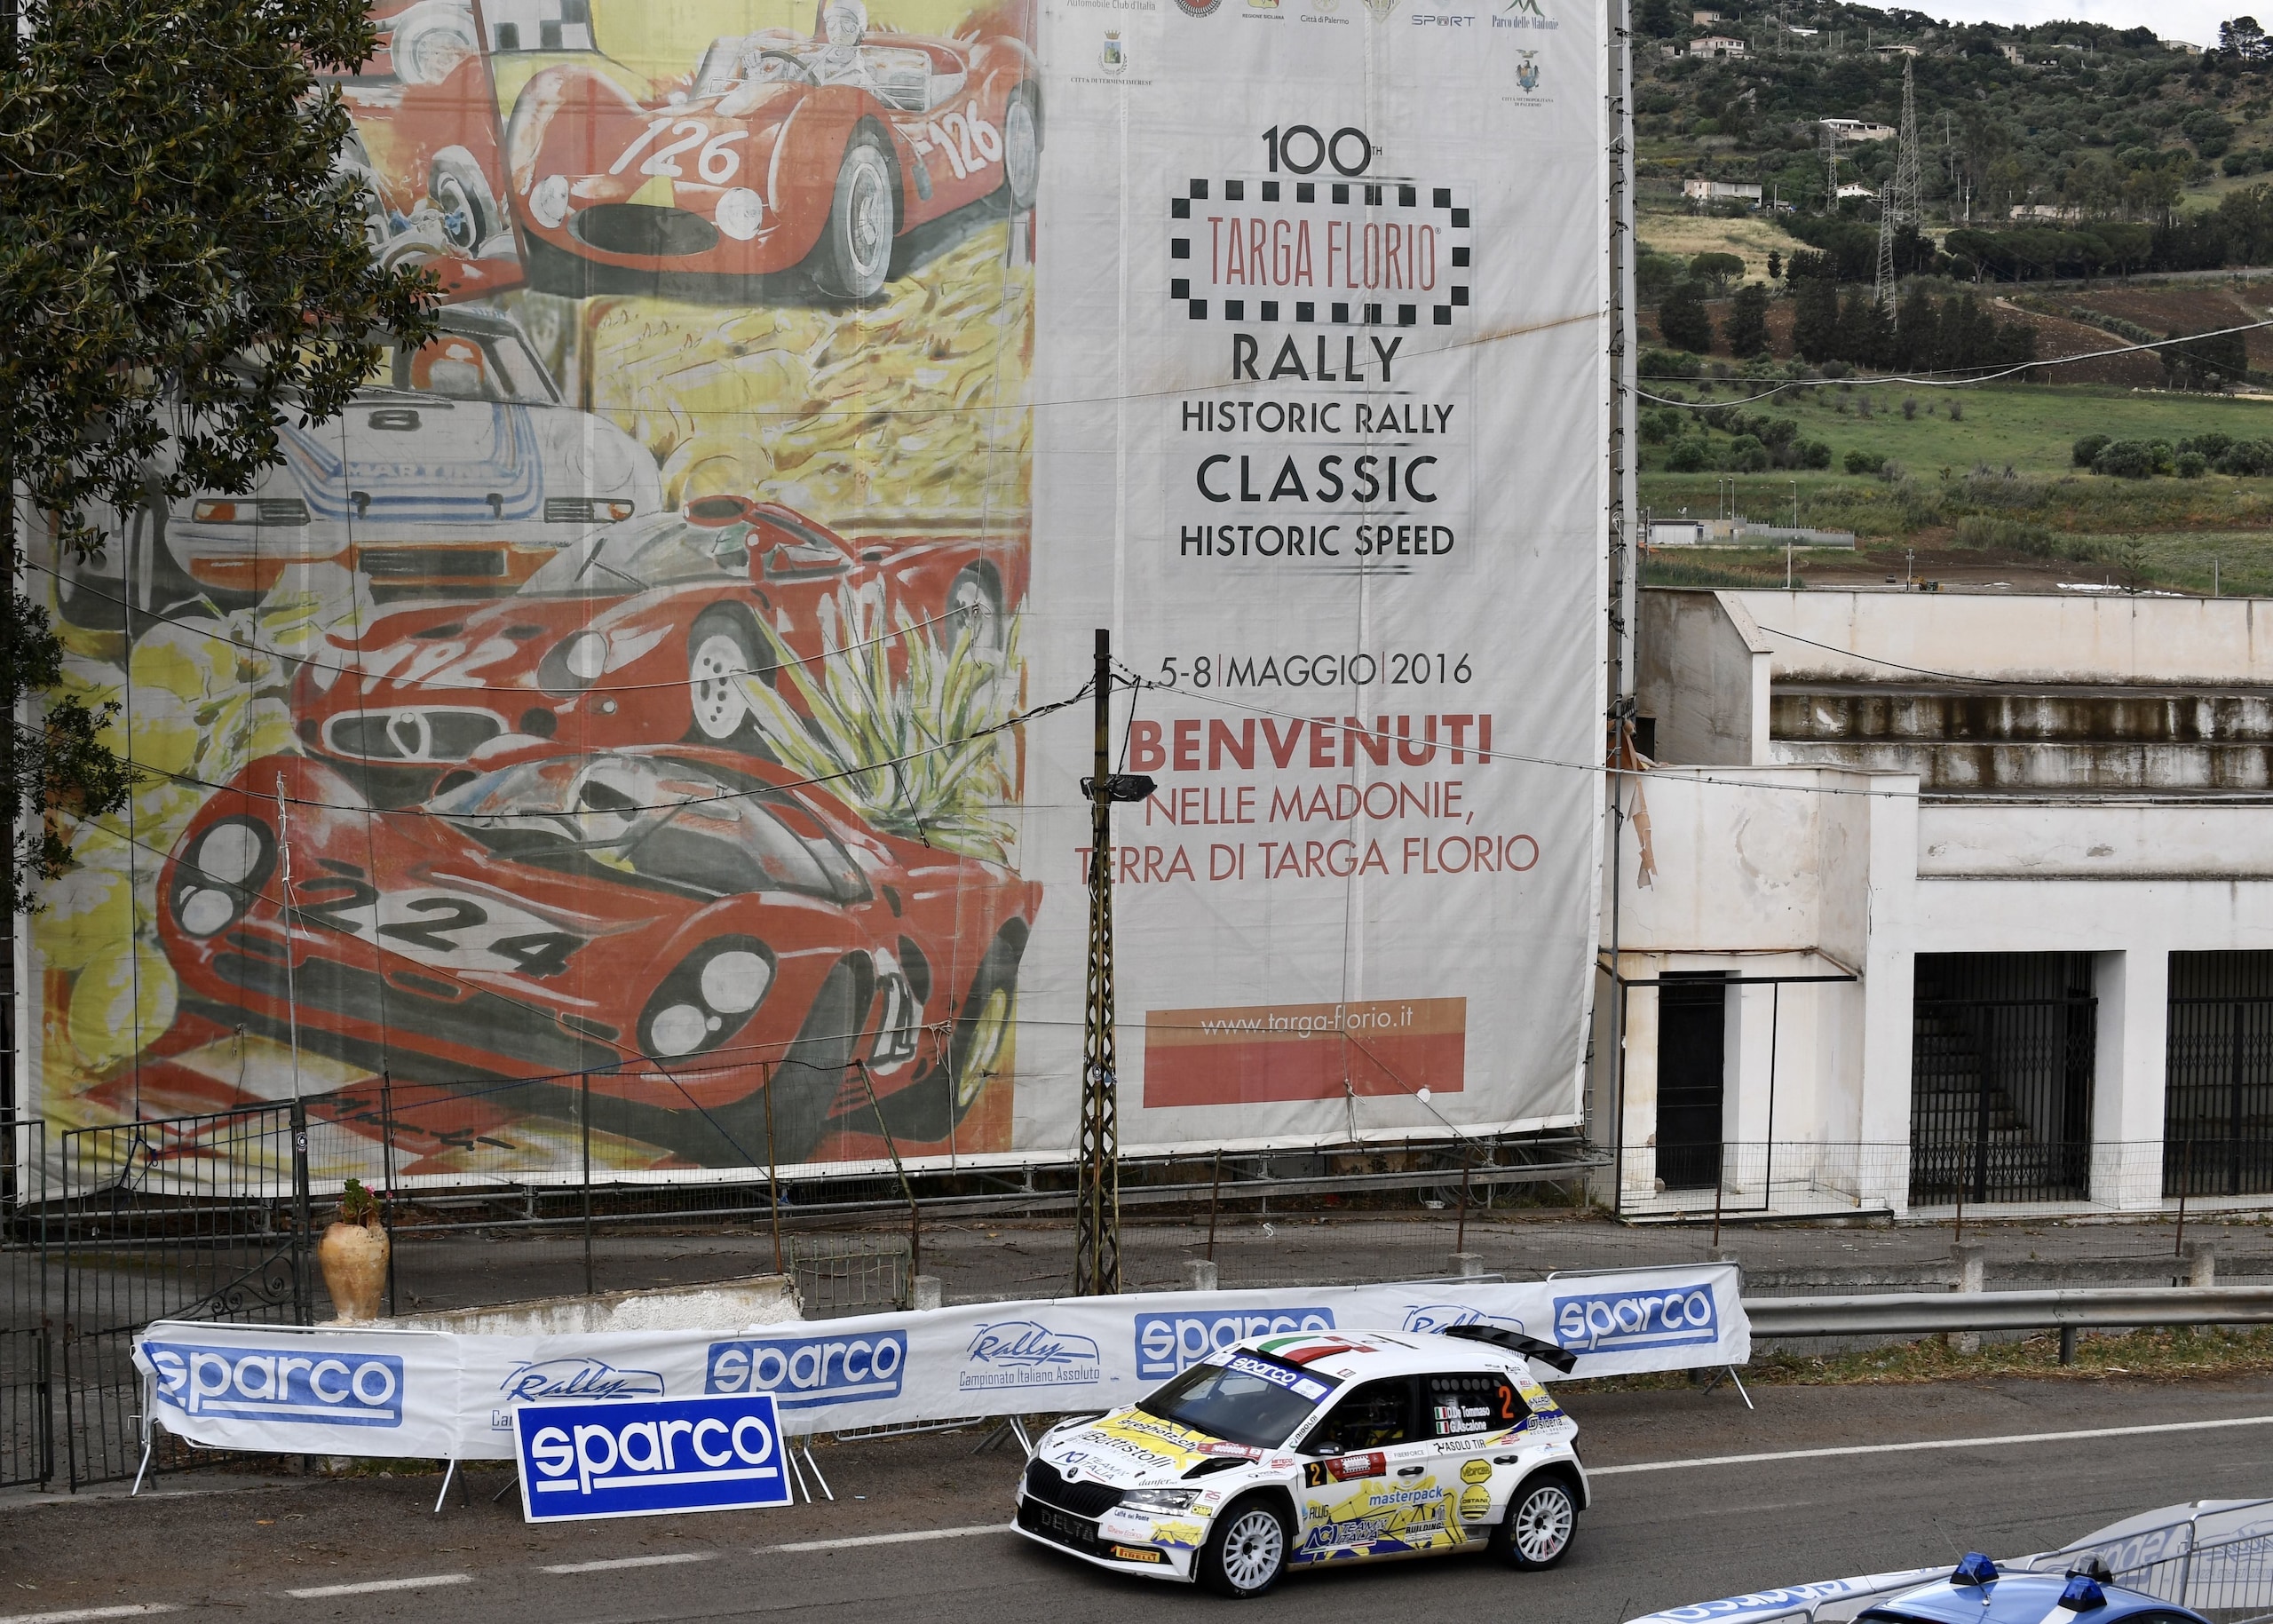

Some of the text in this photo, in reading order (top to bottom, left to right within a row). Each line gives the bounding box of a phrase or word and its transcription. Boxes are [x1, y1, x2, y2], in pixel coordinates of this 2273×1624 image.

[1112, 0, 1129, 9] Club
[1130, 0, 1156, 11] d'Italia
[1300, 14, 1317, 23] Città
[1324, 16, 1350, 25] Palermo
[1492, 14, 1559, 30] Parco delle Madonie
[610, 115, 748, 185] 126
[929, 99, 1002, 180] 126
[1208, 217, 1436, 291] TARGA FLORIO
[1233, 333, 1403, 383] RALLY
[1182, 400, 1454, 434] HISTORIC RALLY
[1196, 454, 1438, 503] CLASSIC
[1181, 524, 1454, 556] HISTORIC SPEED
[1160, 653, 1473, 688] 5-8 MAGGIO 2016
[1129, 714, 1492, 772] BENVENUTI
[1145, 780, 1475, 827] NELLE MADONIE,
[1209, 843, 1244, 882] DI
[1258, 837, 1390, 879] TARGA
[1403, 833, 1540, 875] FLORIO
[1200, 1004, 1414, 1040] www.targa-florio.it
[1560, 1290, 1712, 1351] sparco
[714, 1336, 901, 1393] sparco
[970, 1330, 1066, 1366] Rally
[151, 1350, 396, 1413] sparco
[507, 1368, 630, 1402] Rally
[960, 1365, 1100, 1387] Campionato Italiano Assoluto
[1232, 1357, 1296, 1382] sparco
[1461, 1406, 1490, 1417] Tommaso
[1498, 1385, 1515, 1419] 2
[1117, 1418, 1196, 1452] greghotz.ch
[1445, 1438, 1486, 1452] ASOLO TIR
[532, 1415, 773, 1495] sparco
[1077, 1460, 1115, 1480] ITALIA
[1394, 1449, 1425, 1458] FIBERFORCE
[1311, 1463, 1320, 1485] 2
[1192, 1504, 1212, 1516] OMP
[1369, 1485, 1443, 1506] masterpack
[1136, 1513, 1150, 1522] Ponte
[1342, 1521, 1377, 1533] TEAM
[1336, 1531, 1378, 1544] ITALIA
[1119, 1549, 1157, 1561] PIRELLI
